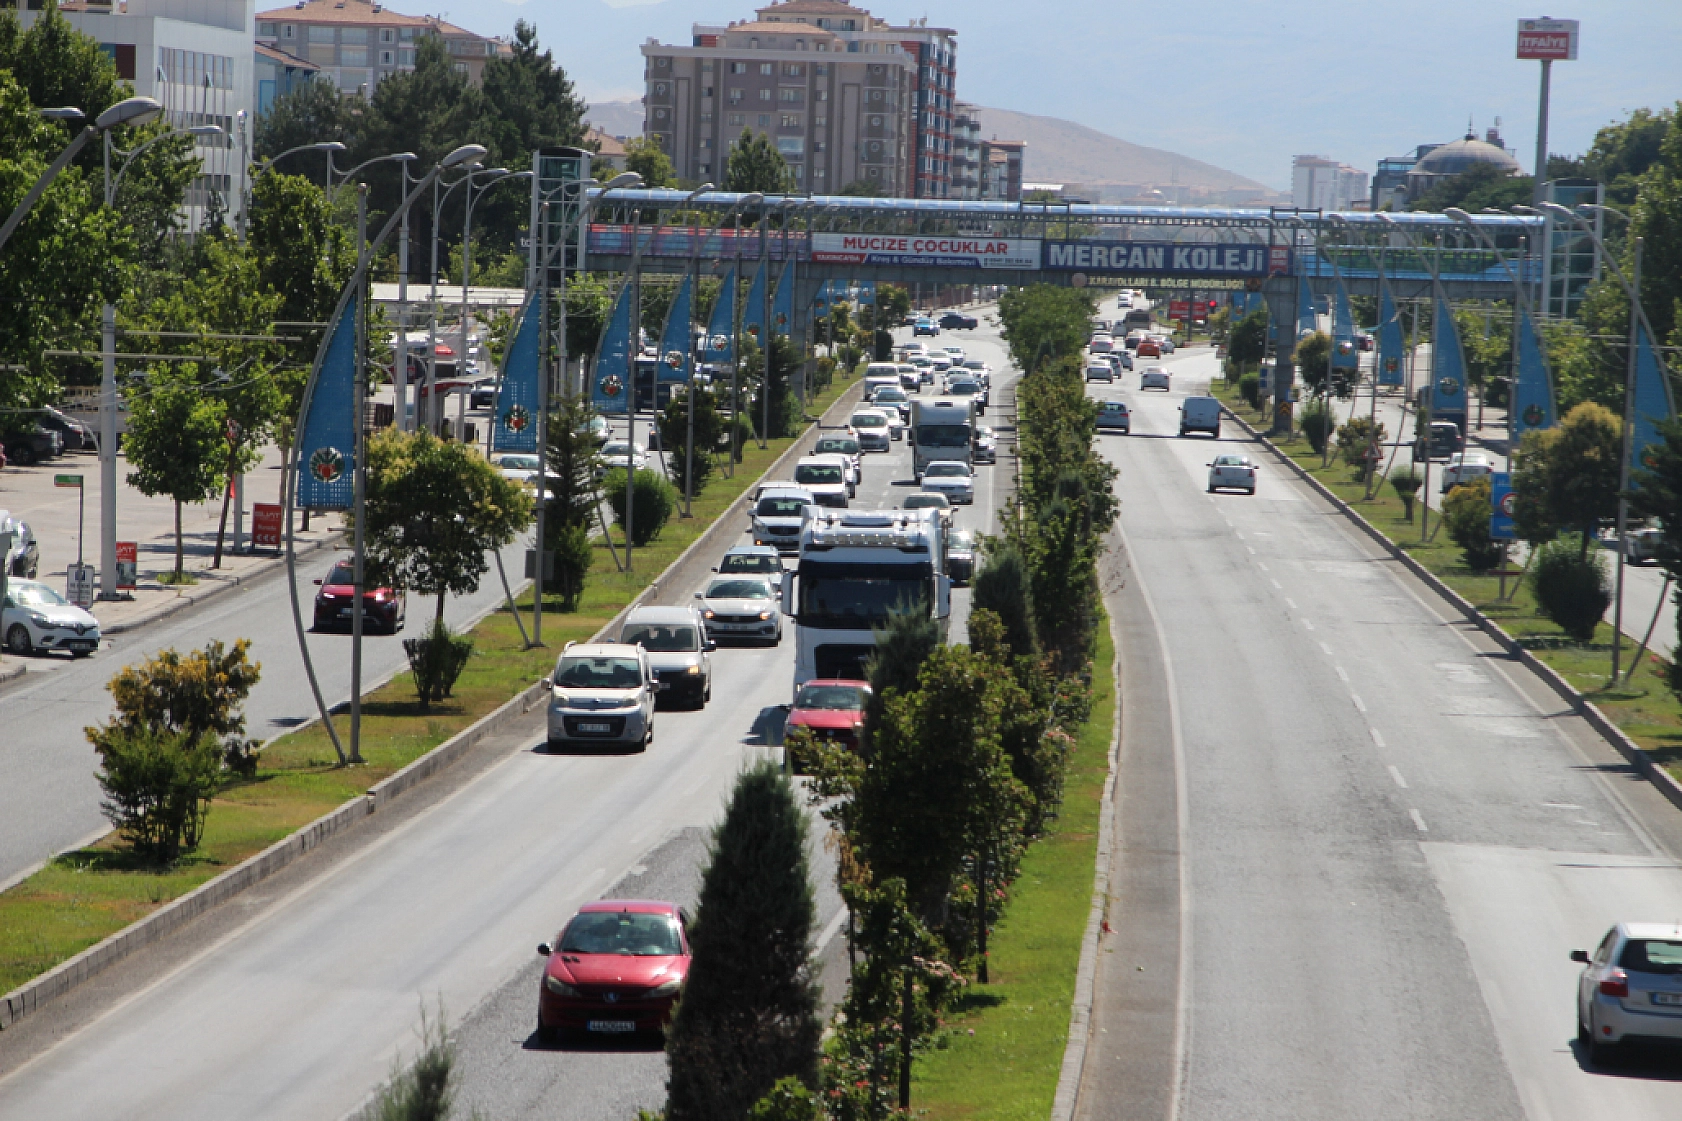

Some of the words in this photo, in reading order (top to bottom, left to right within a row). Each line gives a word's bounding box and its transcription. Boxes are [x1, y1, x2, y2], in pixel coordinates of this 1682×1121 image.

[843, 236, 908, 251] MUCİZE
[913, 239, 1008, 255] ÇOCUKLAR
[1050, 244, 1164, 268] MERCAN
[1172, 247, 1263, 271] KOLEJİ
